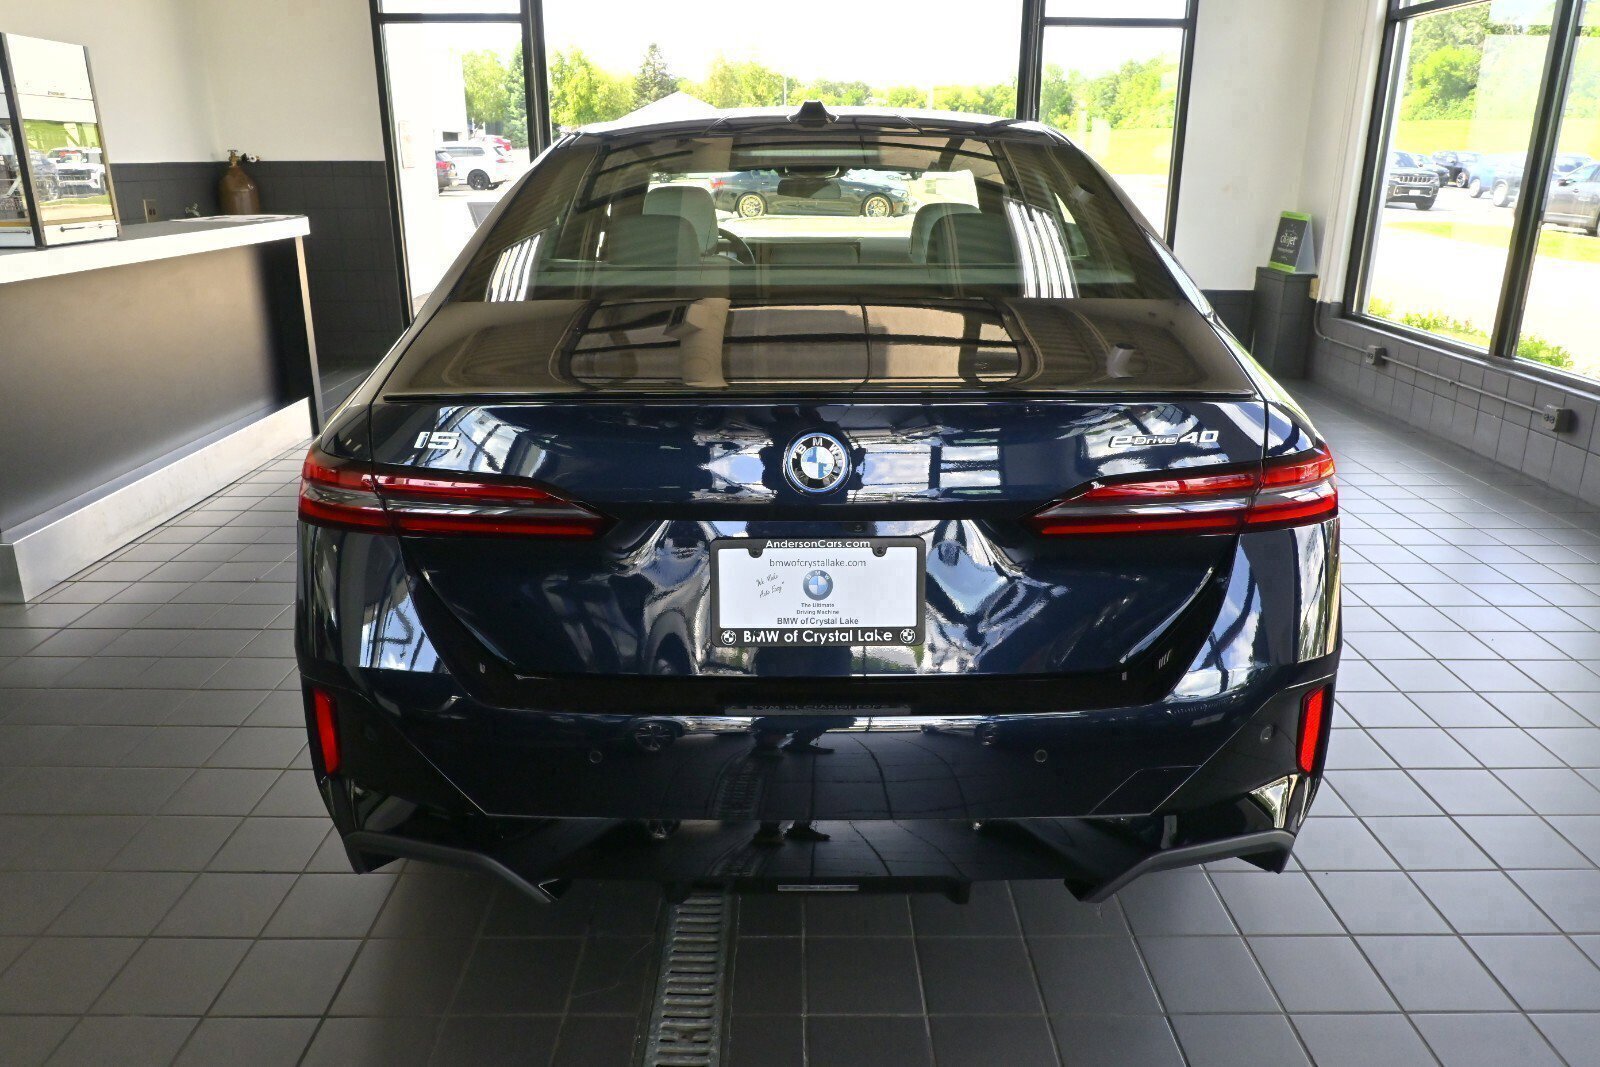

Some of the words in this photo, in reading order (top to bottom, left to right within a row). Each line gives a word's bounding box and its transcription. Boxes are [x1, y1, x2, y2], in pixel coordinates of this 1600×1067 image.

[765, 539, 871, 549] AndersonCars.com
[769, 558, 867, 569] bmwofcrystallake.com
[776, 617, 799, 625] BMW
[800, 617, 809, 625] of
[809, 617, 838, 627] Crystal
[839, 616, 859, 625] Lake
[743, 629, 780, 643] BMW
[784, 629, 799, 643] of
[802, 629, 853, 645] Crystal
[857, 628, 893, 642] Lake
